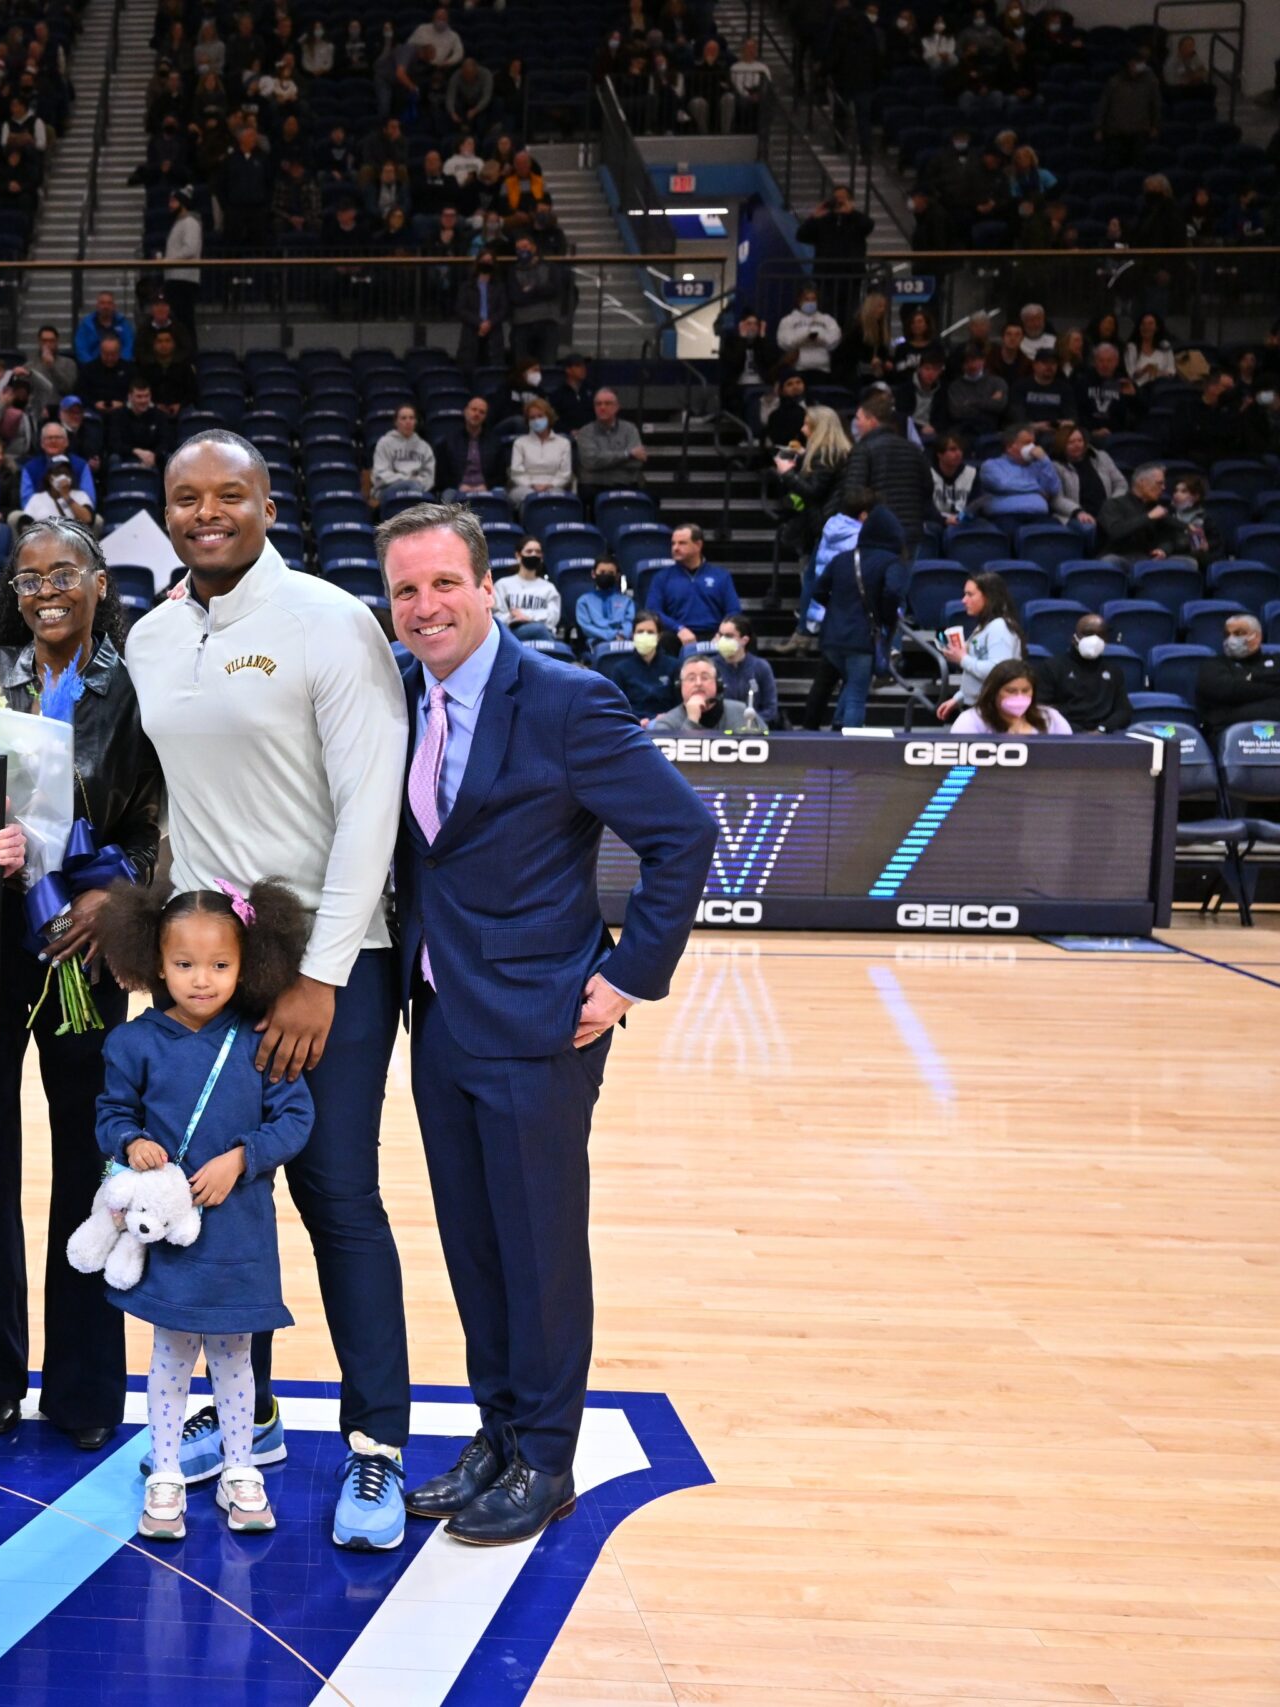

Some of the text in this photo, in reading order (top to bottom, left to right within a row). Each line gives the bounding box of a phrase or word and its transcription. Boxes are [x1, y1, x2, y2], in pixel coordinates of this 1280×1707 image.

[675, 283, 704, 296] 102
[895, 280, 925, 294] 103
[224, 654, 277, 676] VILLANOVA
[652, 738, 769, 763] GEICO
[904, 741, 1029, 766] GEICO
[695, 900, 763, 923] ICO
[896, 904, 1019, 928] GEICO
